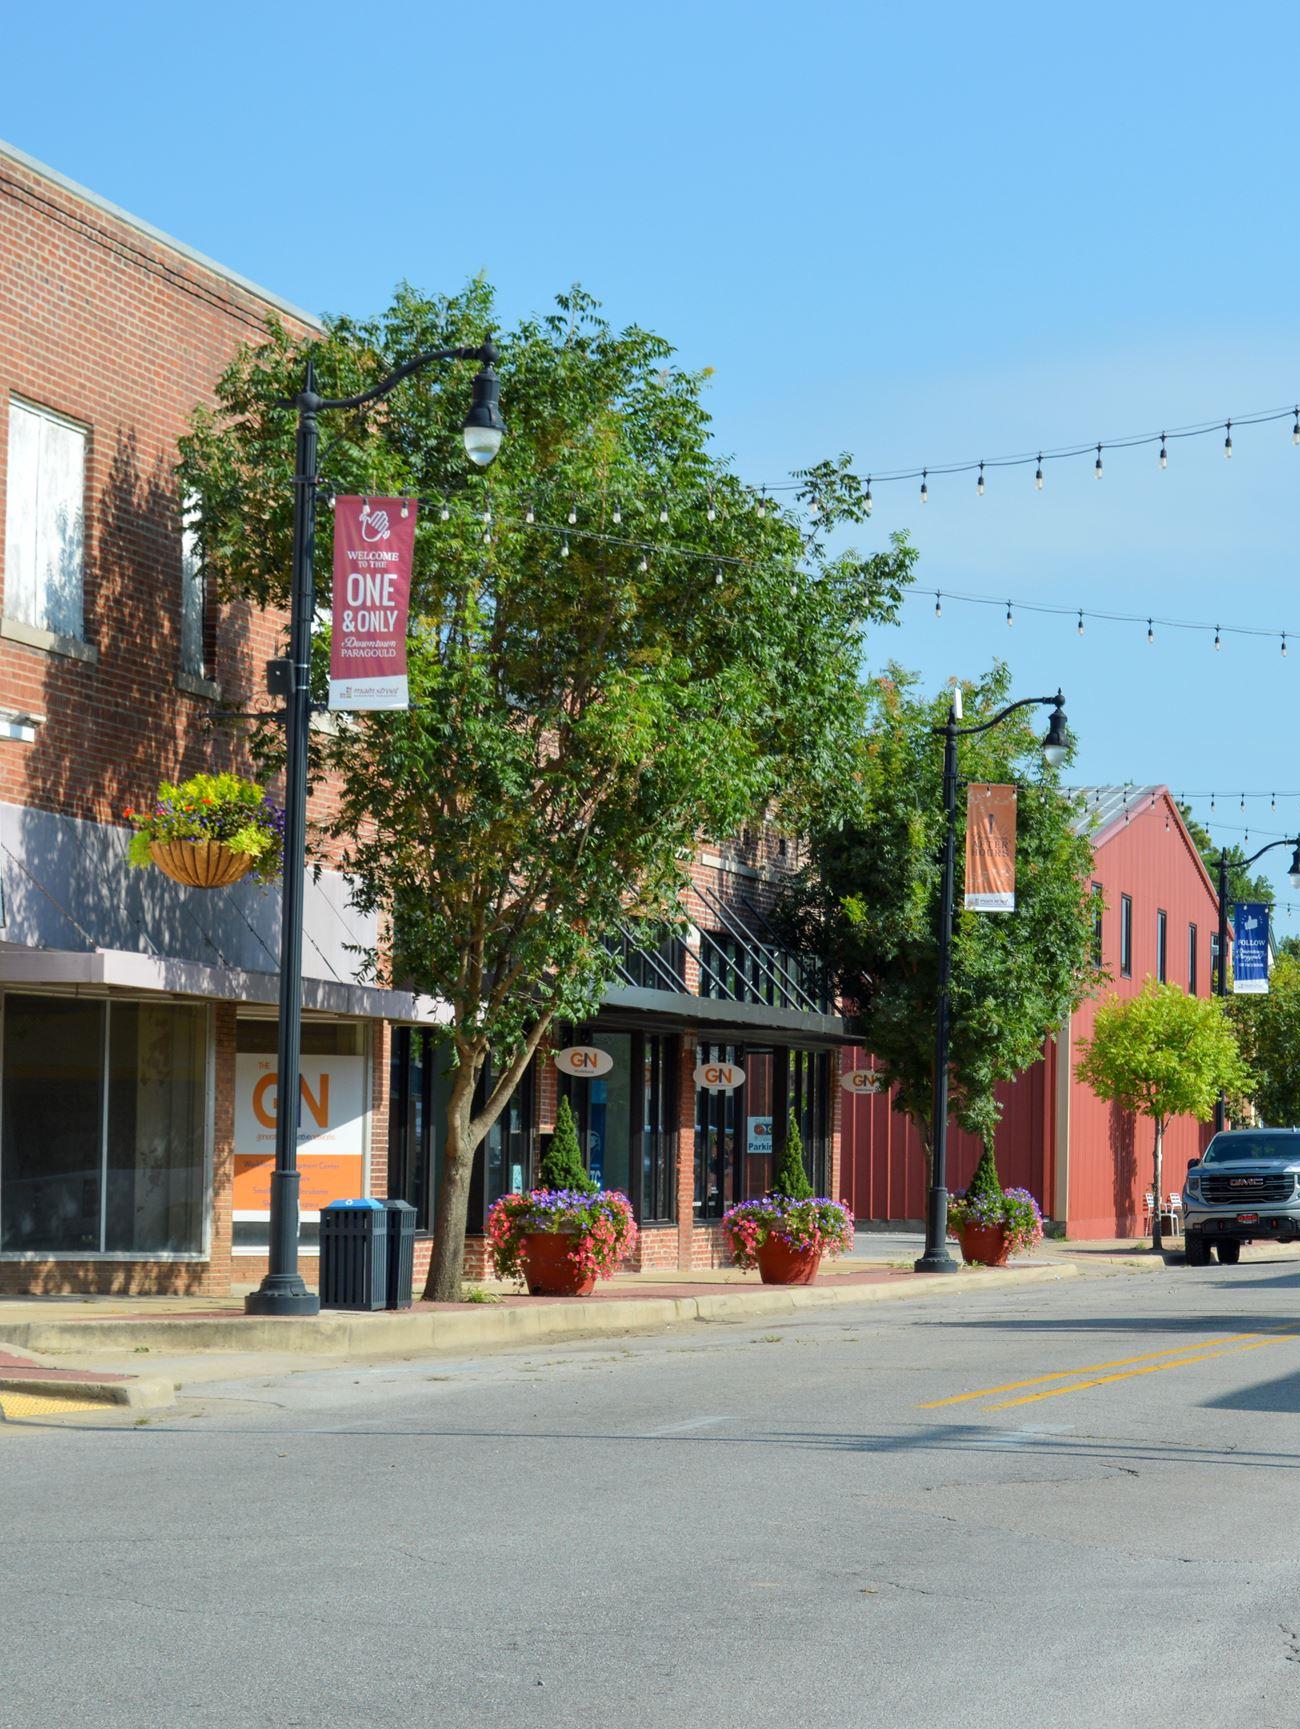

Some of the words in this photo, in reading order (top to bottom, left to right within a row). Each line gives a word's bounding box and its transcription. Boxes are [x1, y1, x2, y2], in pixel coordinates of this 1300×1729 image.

[347, 551, 399, 561] WELCOME
[358, 561, 368, 569] TO
[370, 561, 387, 569] THE
[347, 573, 398, 607] ONE
[341, 637, 397, 648] Downtown
[341, 649, 397, 658] PARAGOULD
[571, 1052, 597, 1068] GN
[705, 1068, 732, 1084] GN
[853, 1074, 877, 1087] GN
[252, 1072, 330, 1130] GN
[1230, 1178, 1264, 1187] GMC
